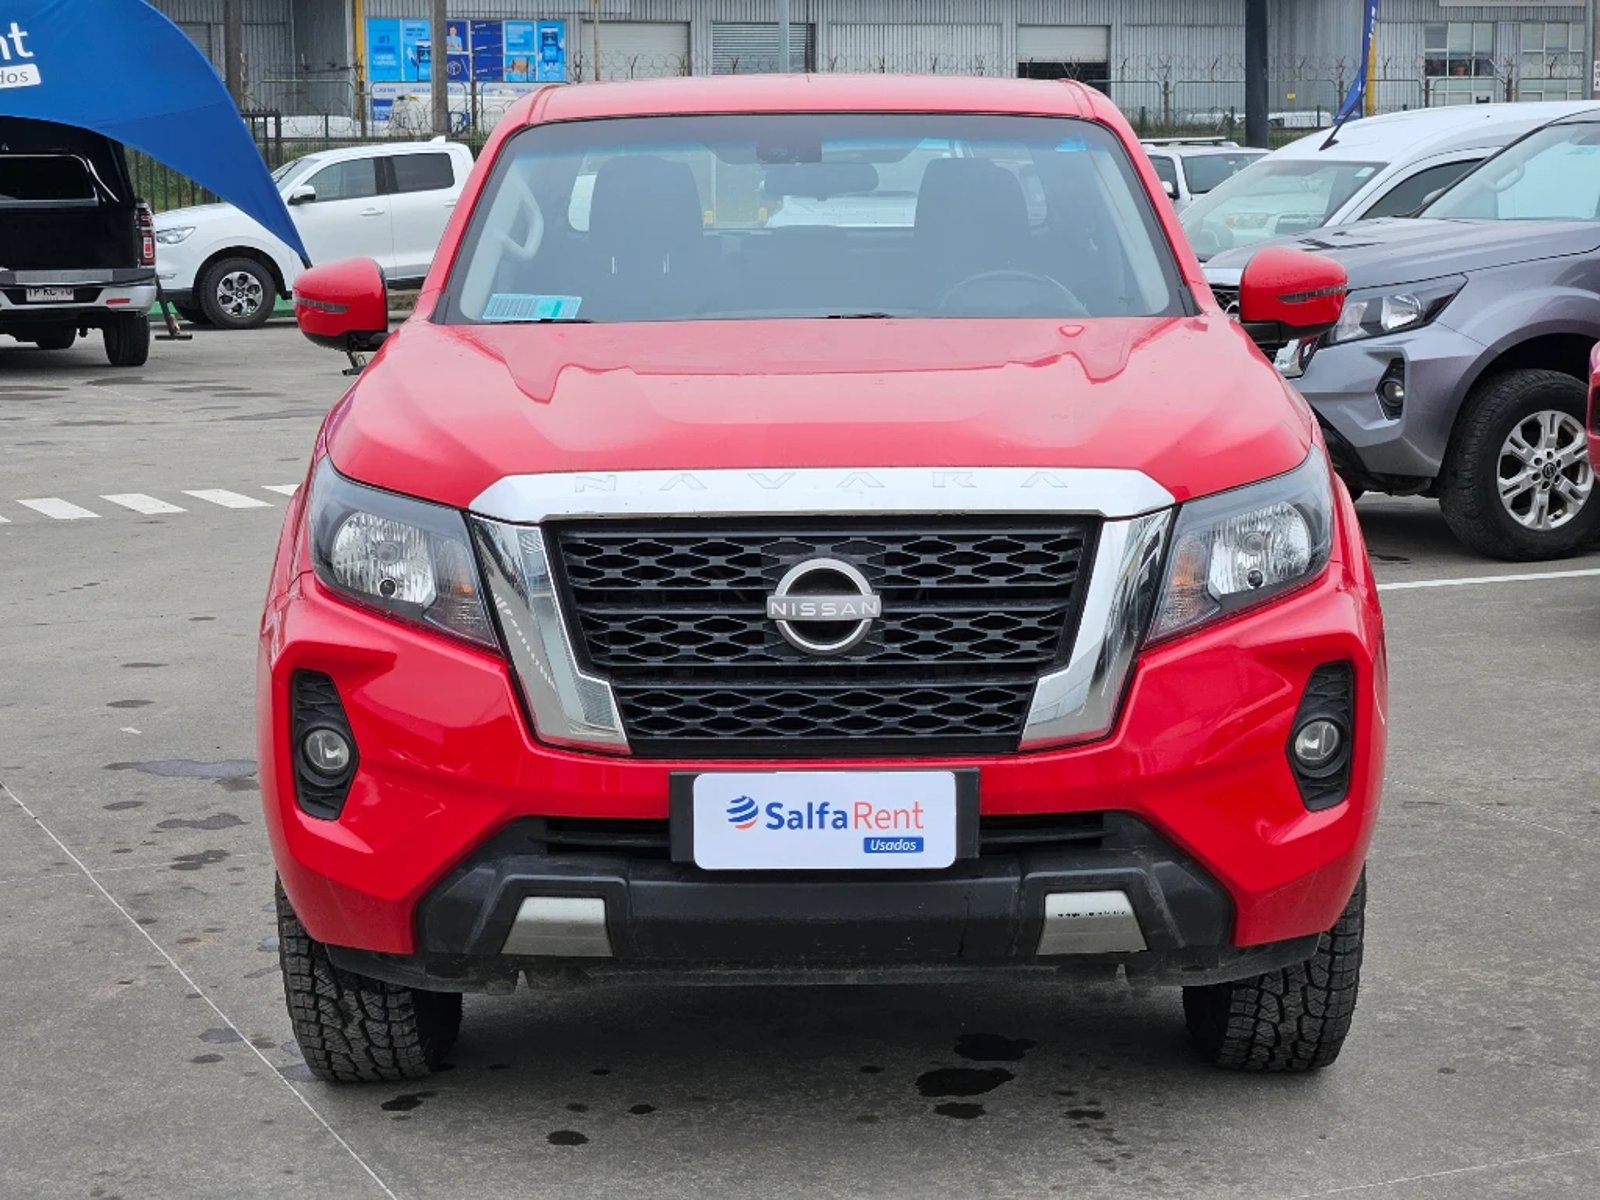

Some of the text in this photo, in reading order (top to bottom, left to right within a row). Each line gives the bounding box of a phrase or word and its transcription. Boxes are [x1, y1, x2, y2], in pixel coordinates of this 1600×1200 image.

[574, 471, 1069, 493] NAVARA
[770, 601, 878, 616] NISSAN
[765, 800, 924, 830] SalfaRent
[870, 838, 917, 852] Usados
